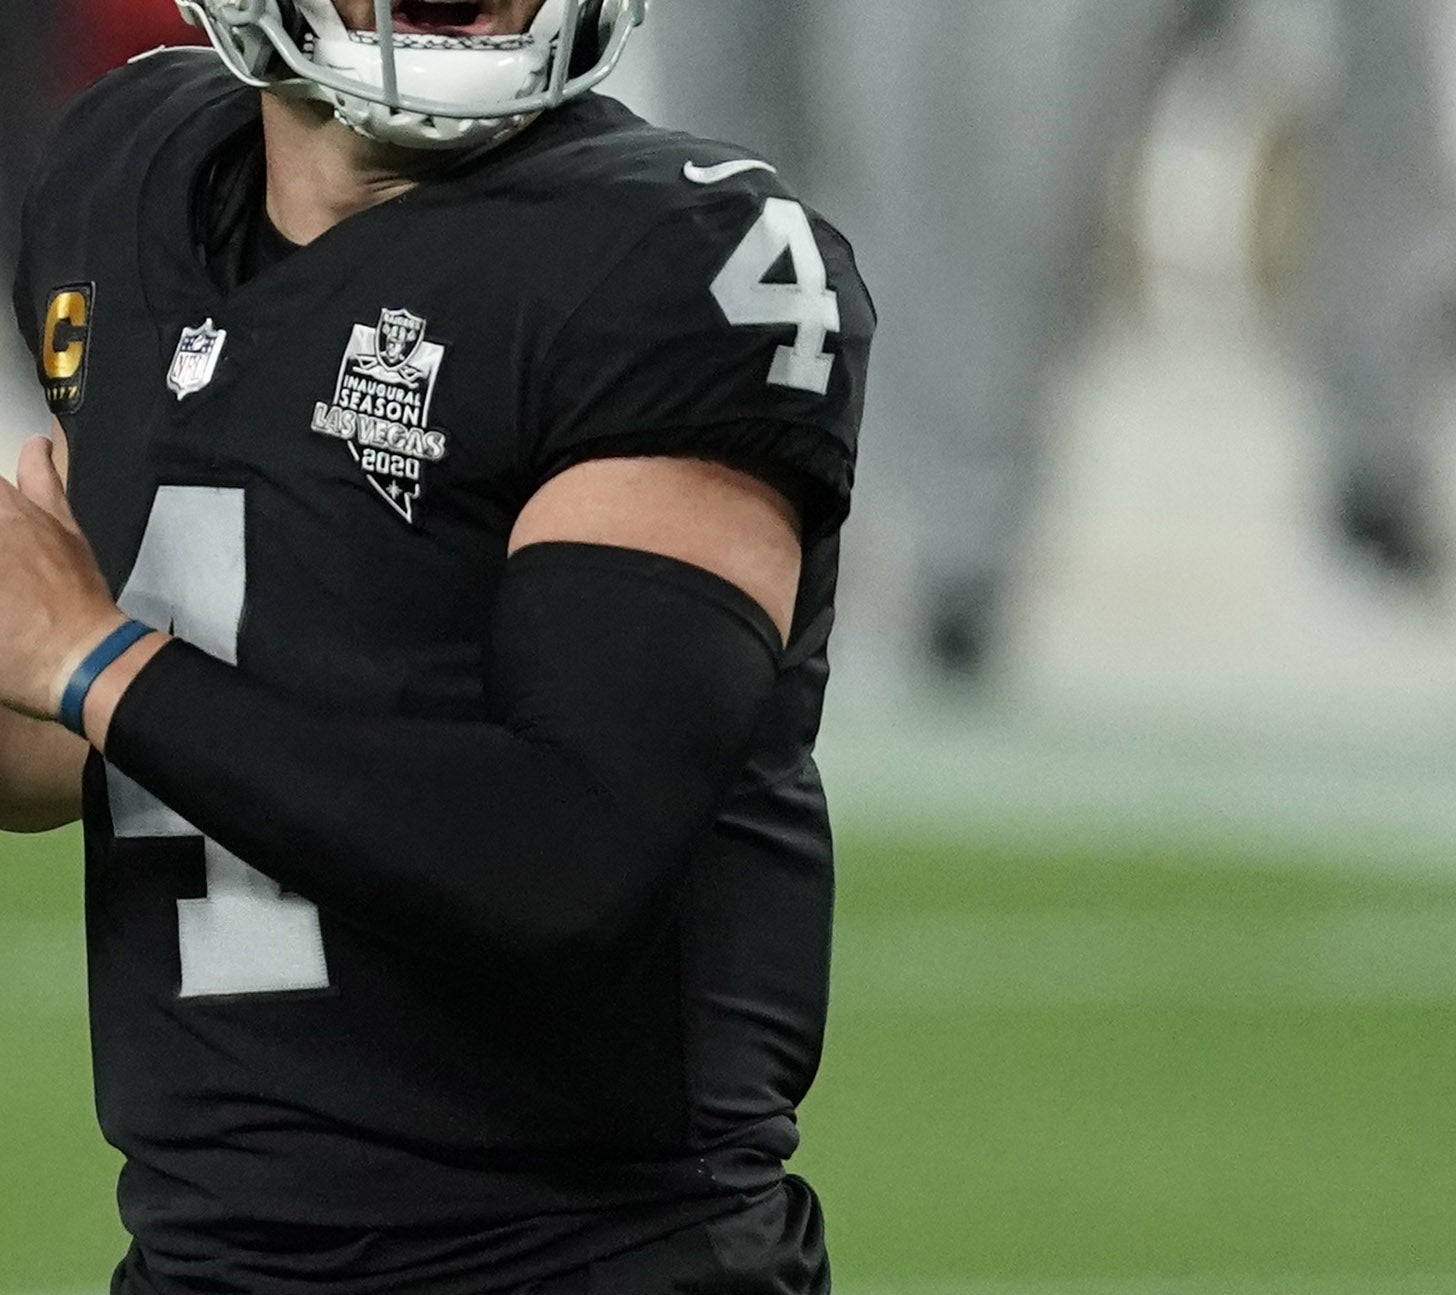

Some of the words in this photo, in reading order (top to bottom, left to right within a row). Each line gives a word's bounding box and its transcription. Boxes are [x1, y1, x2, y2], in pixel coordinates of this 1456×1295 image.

[708, 197, 840, 396] 4
[43, 292, 87, 379] C
[338, 388, 420, 426] SEASON
[343, 375, 422, 407] INAUGURAL
[311, 401, 357, 440] LAS
[356, 413, 446, 461] VEGAS
[360, 447, 420, 480] 2020
